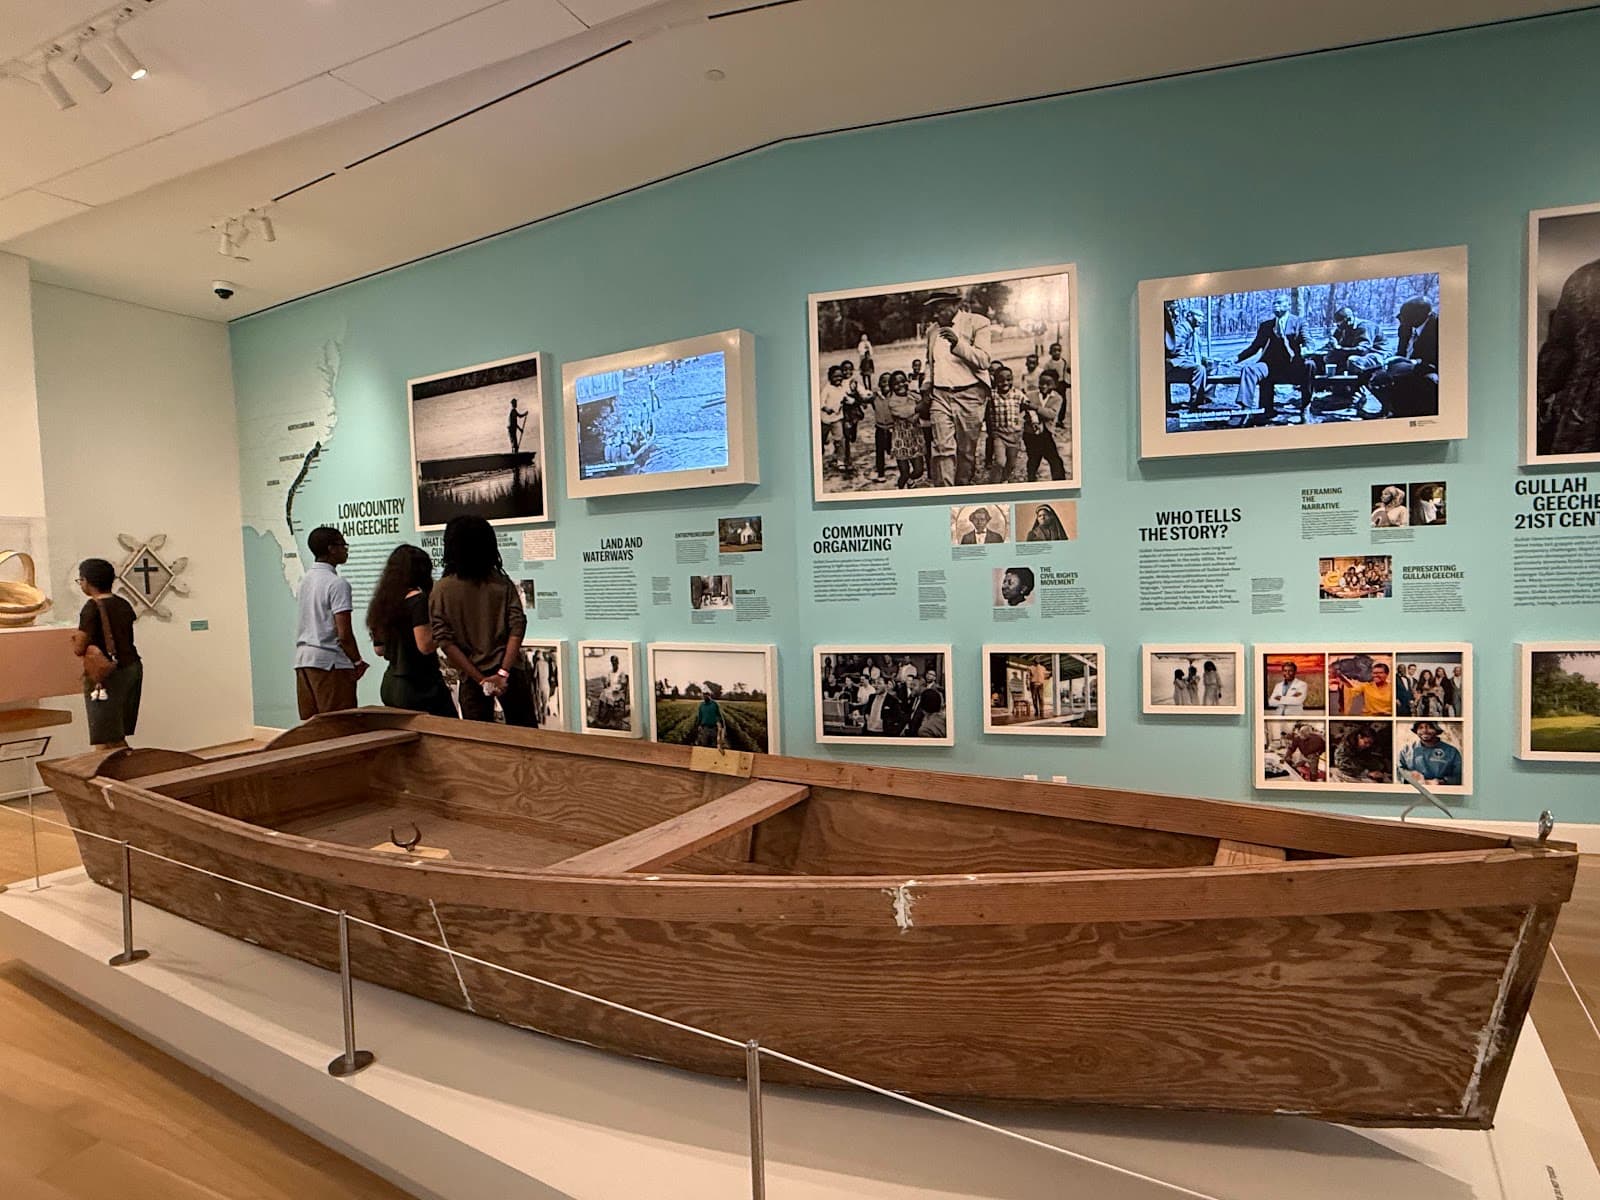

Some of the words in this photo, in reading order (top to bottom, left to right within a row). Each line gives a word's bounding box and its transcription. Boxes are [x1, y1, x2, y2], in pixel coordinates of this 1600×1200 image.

[1302, 487, 1343, 495] REFRAMING
[1515, 477, 1587, 495] GULLAH
[338, 498, 405, 519] LOWCOUNTRY
[1302, 502, 1340, 510] NARRATIVE
[1156, 511, 1193, 525] WHO
[1195, 508, 1242, 524] TELLS
[1514, 513, 1556, 529] 21ST
[356, 518, 400, 535] GEECHEE
[822, 523, 904, 539] COMMUNITY
[1138, 527, 1168, 541] THE
[1170, 524, 1228, 540] STORY?
[601, 538, 623, 550] LAND
[625, 536, 643, 549] AND
[813, 538, 892, 554] ORGANIZING
[582, 549, 634, 562] WATERWAYS
[1403, 564, 1457, 573] REPRESENTING
[1432, 571, 1465, 579] GEECHEE
